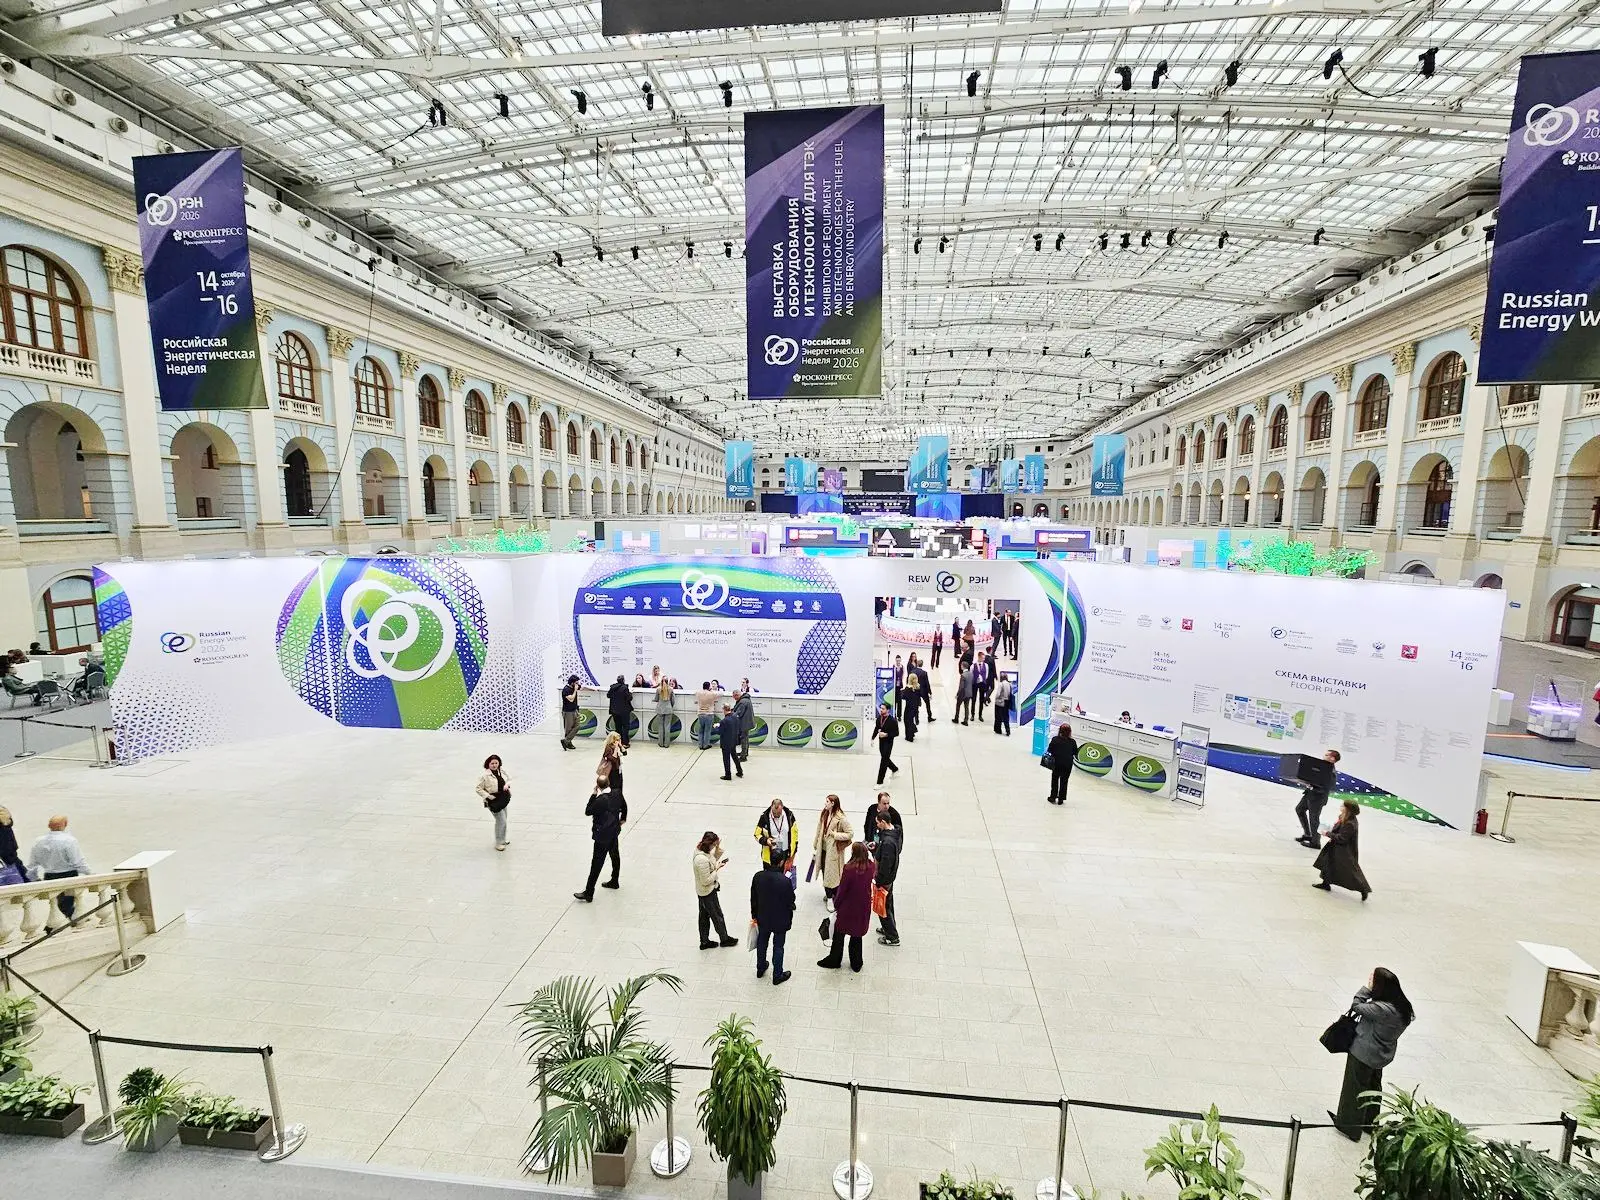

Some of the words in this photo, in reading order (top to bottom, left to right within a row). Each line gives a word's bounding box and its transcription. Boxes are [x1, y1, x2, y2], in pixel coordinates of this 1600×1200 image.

[1585, 108, 1600, 124] R
[1583, 127, 1600, 138] 20
[804, 141, 814, 170] ТЭК
[835, 141, 843, 166] FUEL
[1580, 152, 1600, 162] RO
[804, 172, 816, 202] ДЛЯ
[835, 169, 843, 189] THE
[180, 196, 203, 209] РЭН
[823, 179, 832, 240] EQUIPMENT
[834, 191, 843, 212] FOR
[180, 212, 200, 221] 2026
[846, 199, 854, 250] INDUSTRY
[1587, 206, 1600, 231] 1
[183, 228, 243, 239] РОСКОНГРЕСС
[789, 198, 800, 317] ОБОРУДОВАНИЯ
[802, 206, 815, 304] ТЕХНОЛОГИЙ
[823, 243, 831, 257] OF
[834, 215, 843, 292] TECHNOLOGIES
[774, 242, 784, 317] ВЫСТАВКА
[846, 252, 854, 291] ENERGY
[197, 271, 219, 292] 14
[823, 259, 831, 316] EXHIBITION
[217, 294, 238, 315] 16
[834, 294, 842, 316] AND
[846, 294, 854, 315] AND
[1502, 290, 1588, 309] Russian
[805, 307, 814, 316] И
[1498, 314, 1575, 332] Energy
[163, 336, 228, 349] Российская
[802, 338, 851, 346] Российская
[164, 350, 256, 364] Энергетическая
[802, 348, 864, 356] Энергетическая
[166, 363, 207, 376] Неделя
[802, 357, 830, 366] Неделя
[833, 358, 859, 368] 2026
[908, 575, 930, 583] REW
[969, 576, 989, 584] РЭН
[684, 628, 736, 636] Аккредитация
[1451, 650, 1462, 659] 14
[1461, 662, 1473, 671] 16
[1275, 669, 1308, 682] СХЕМА
[1310, 674, 1367, 690] ВЫСТАВКИ
[1290, 680, 1322, 693] FLOOR
[1324, 684, 1349, 697] PLAN
